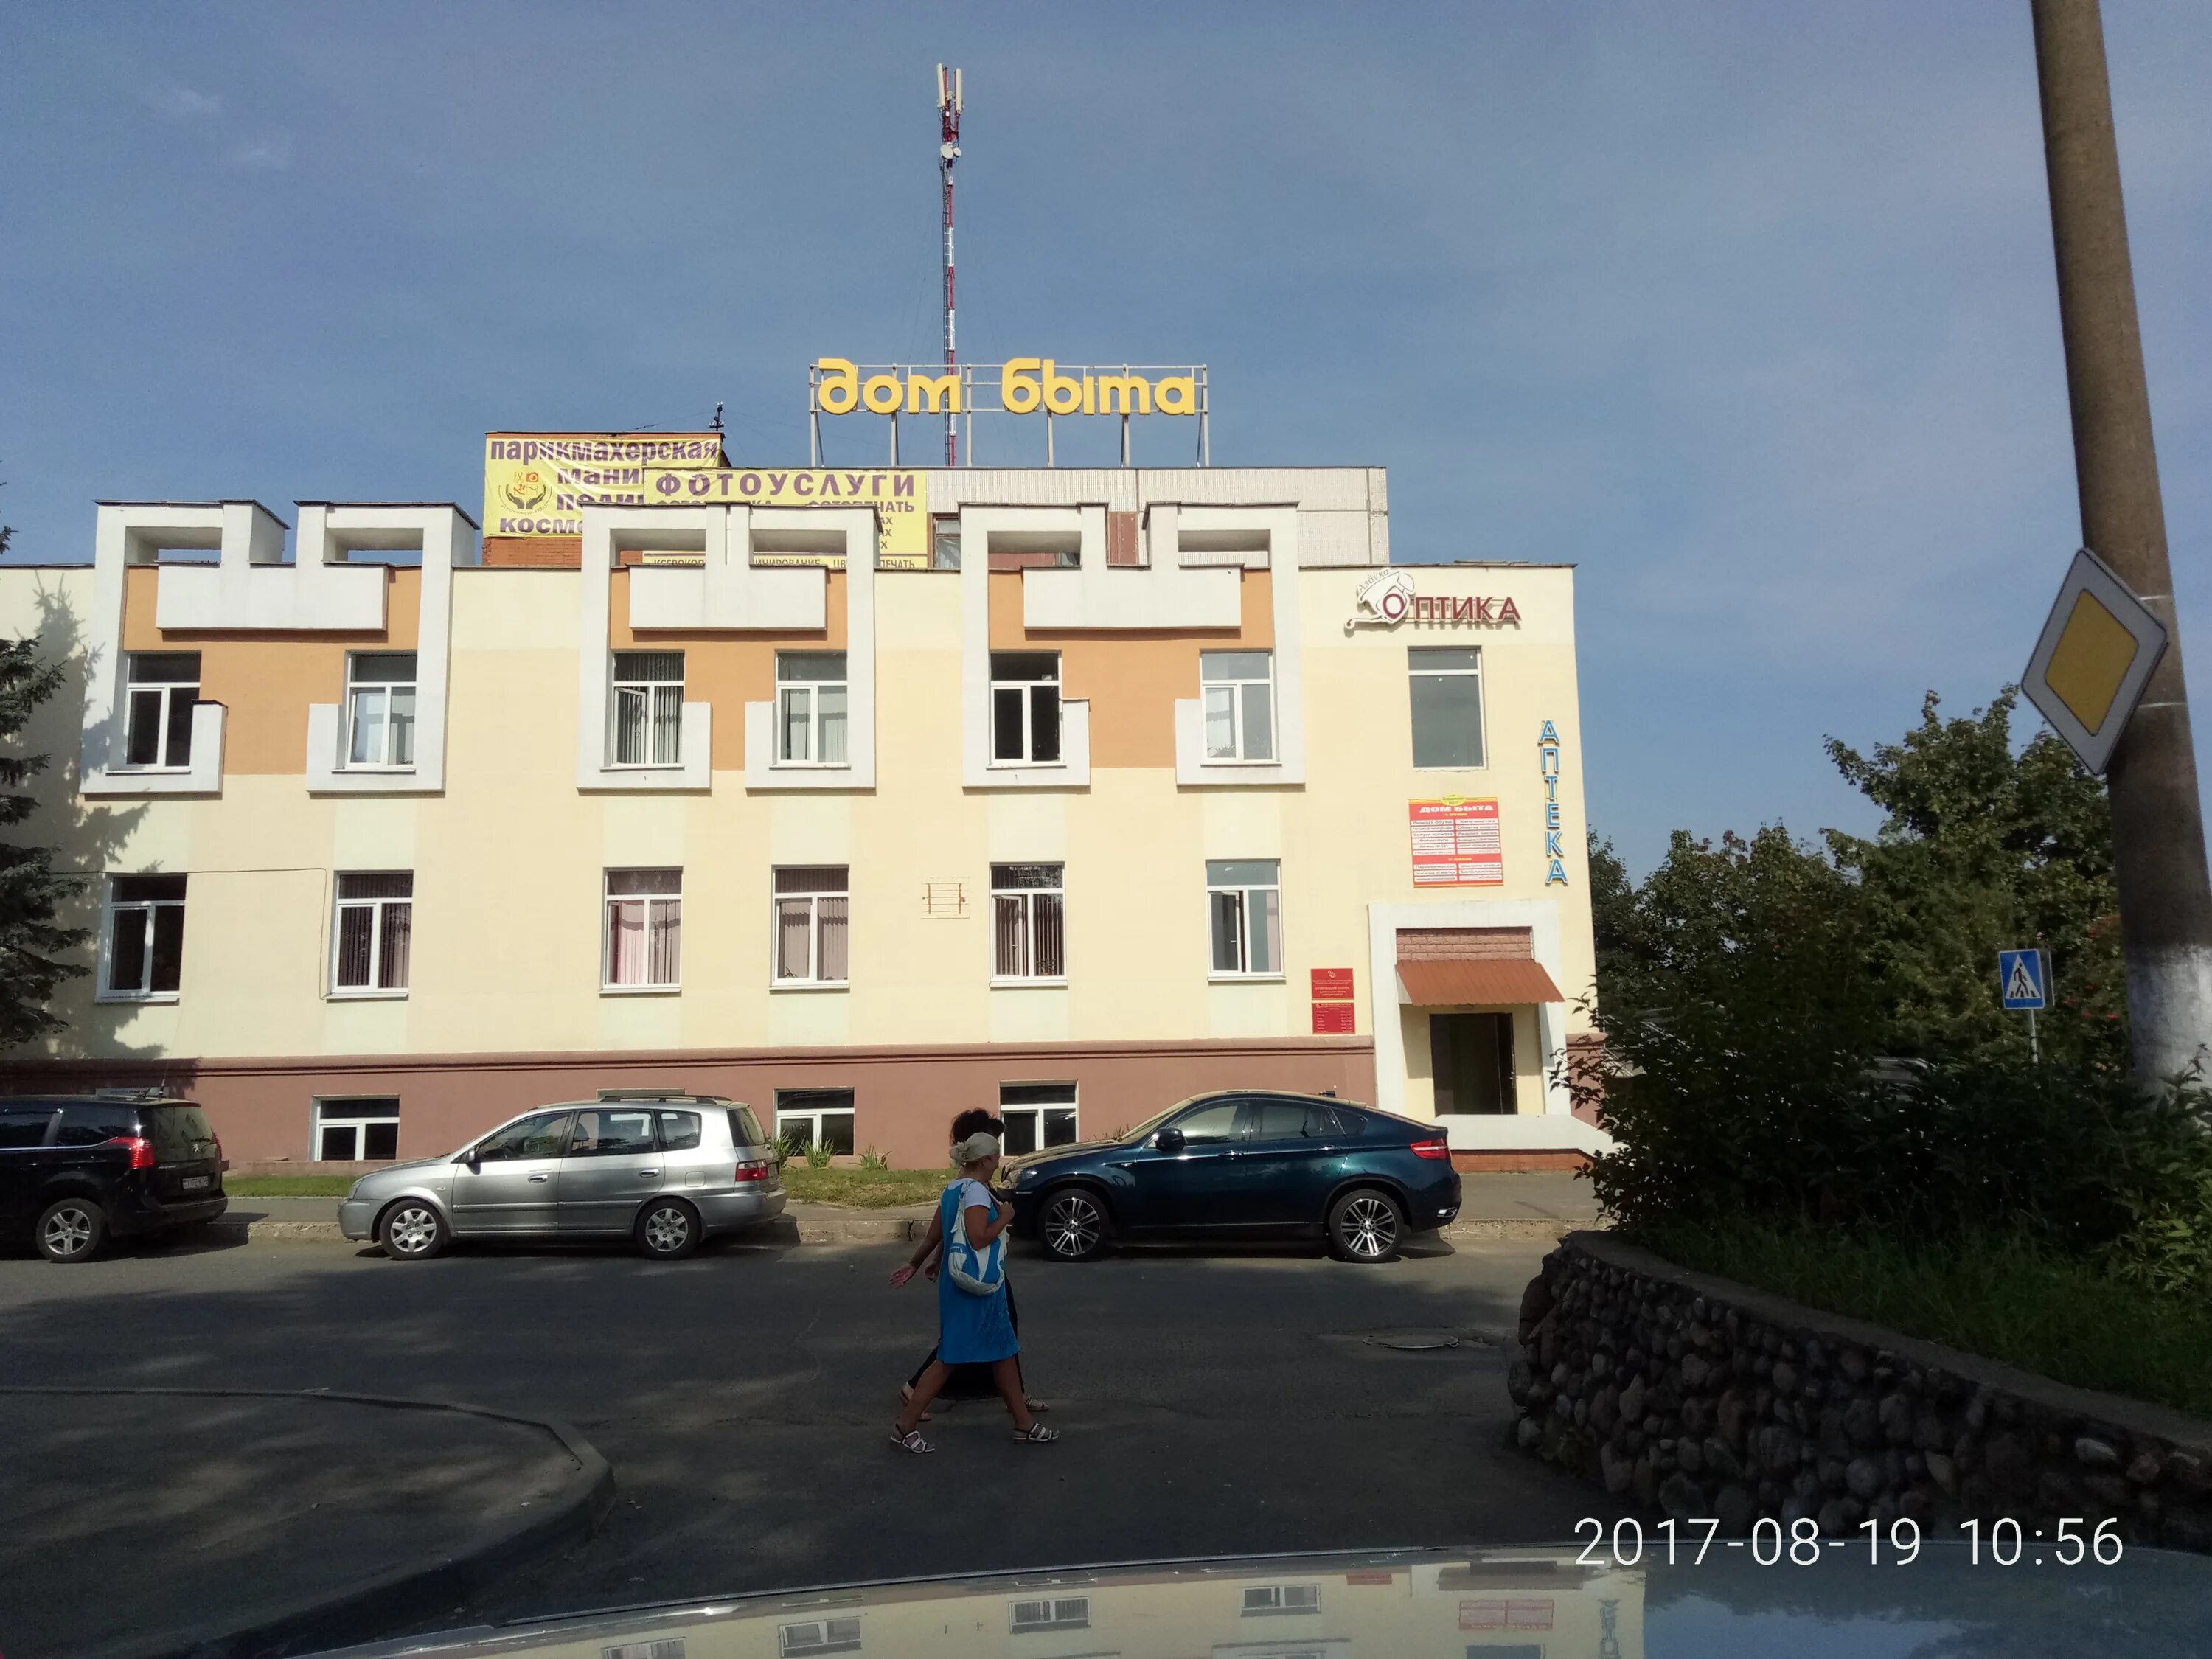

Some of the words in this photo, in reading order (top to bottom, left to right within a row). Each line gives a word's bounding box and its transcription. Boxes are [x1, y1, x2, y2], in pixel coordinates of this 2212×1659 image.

[818, 358, 961, 414] дом
[1001, 358, 1195, 415] быта
[490, 438, 718, 465] парикмахерская
[557, 468, 644, 484] мани
[655, 473, 914, 497] ФОТОУСЛУГИ
[1382, 593, 1521, 621] ОПТИКА
[1537, 719, 1568, 885] АПТЕКА
